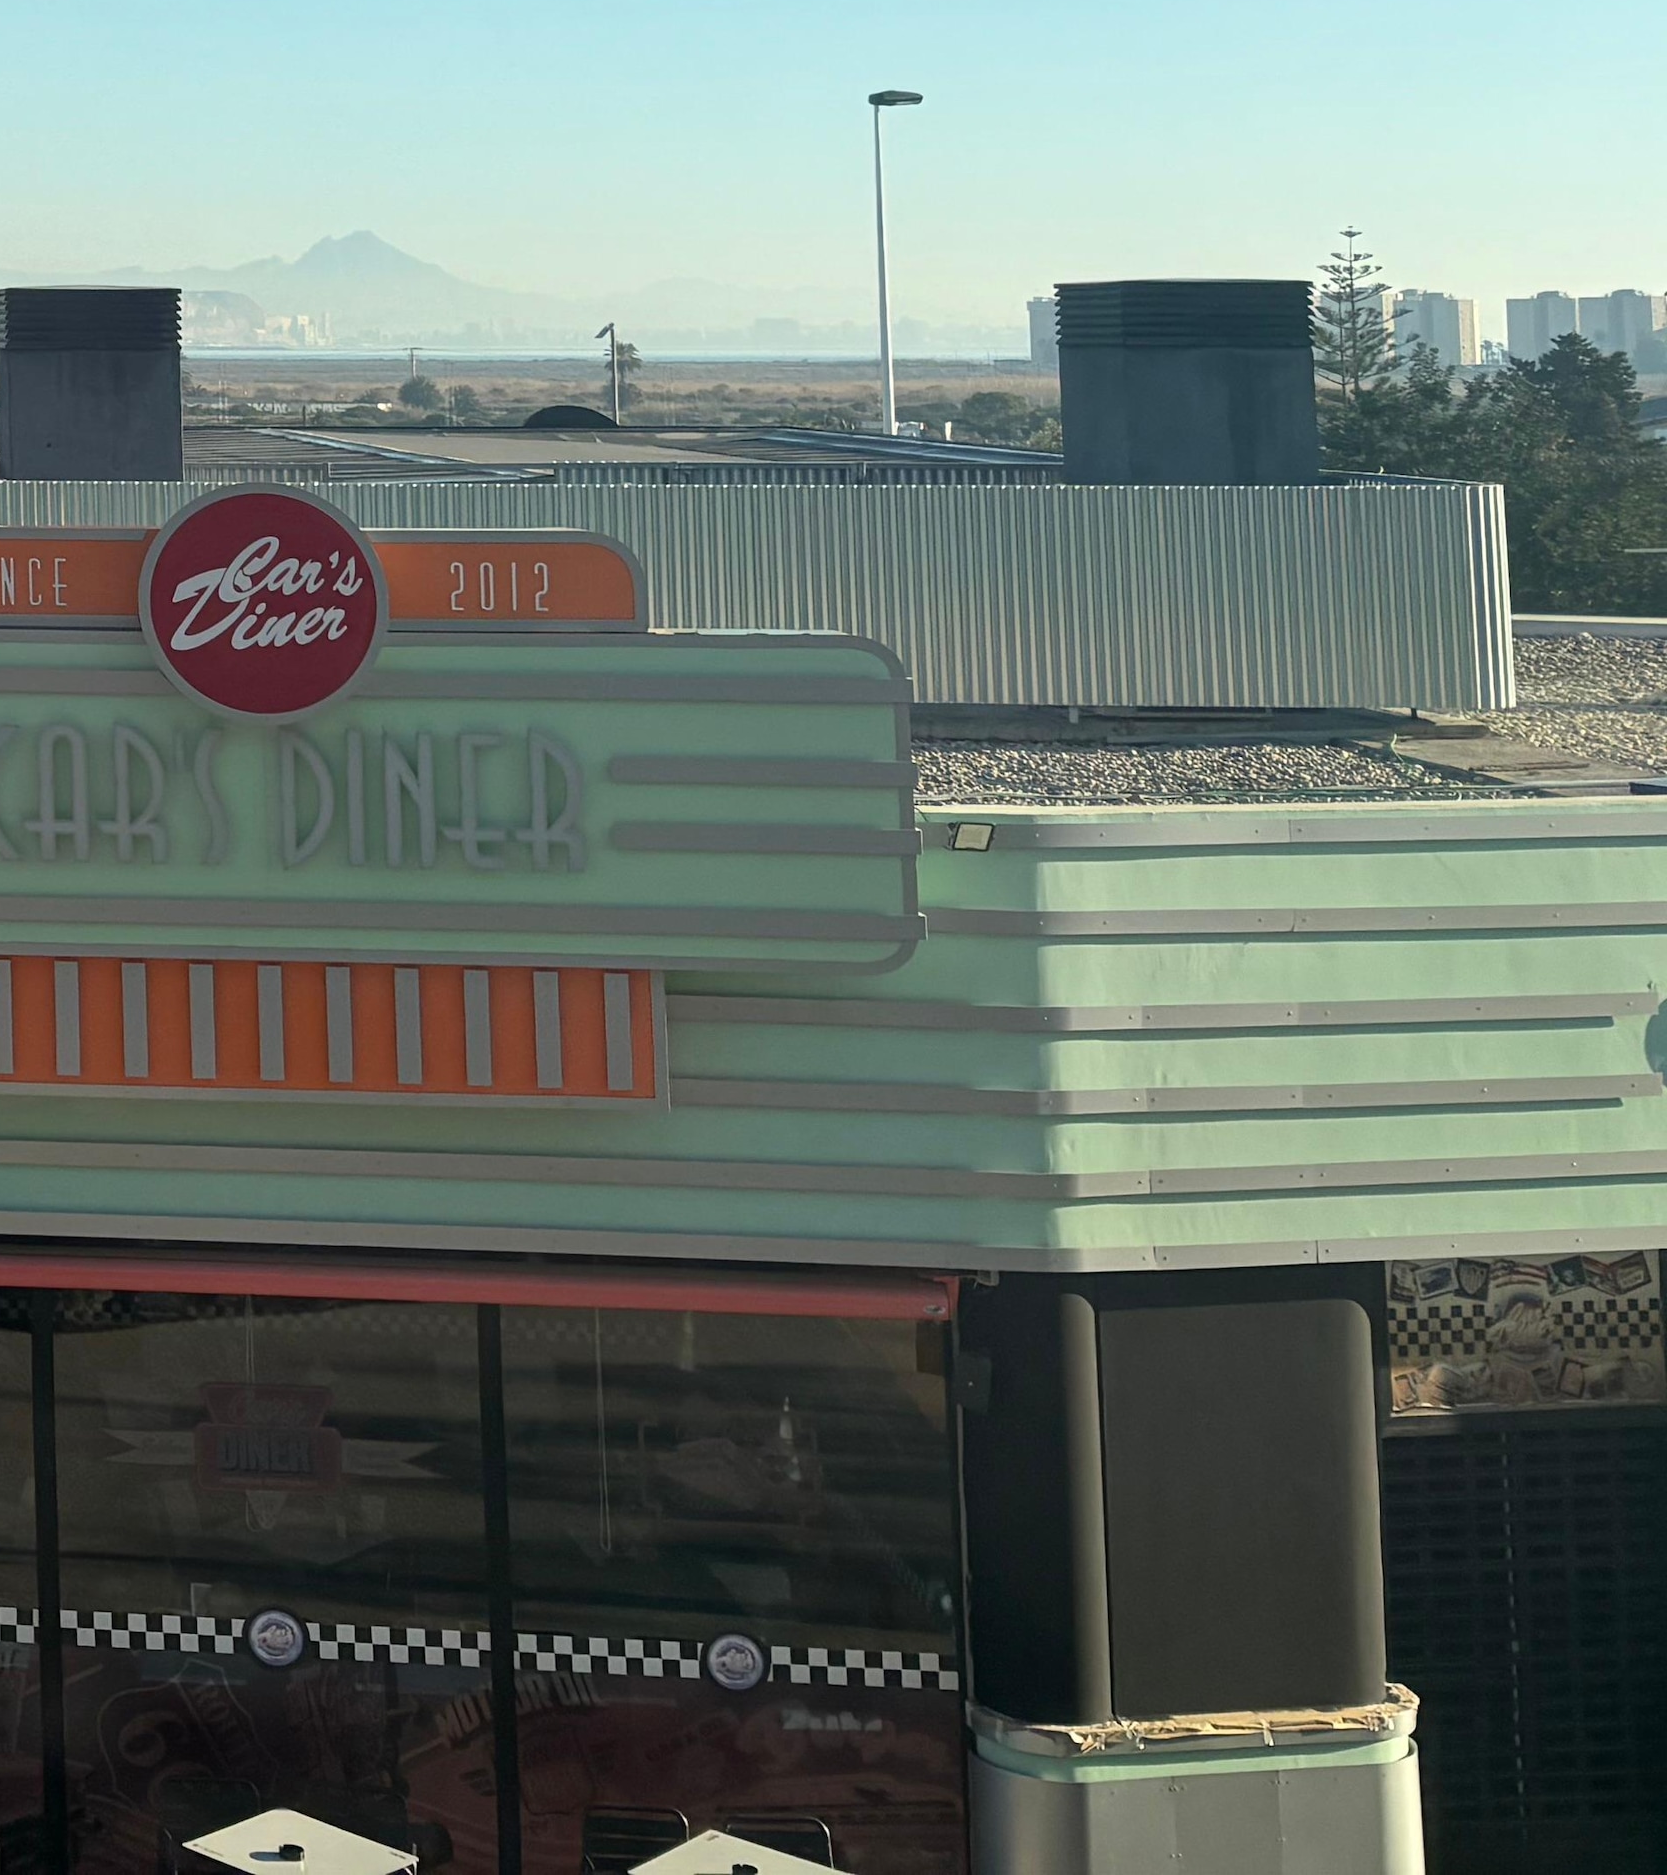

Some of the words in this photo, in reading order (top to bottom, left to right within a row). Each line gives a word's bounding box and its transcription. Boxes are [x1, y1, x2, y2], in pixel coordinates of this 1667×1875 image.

[218, 535, 363, 603] Car's
[450, 562, 549, 612] 2012
[170, 567, 348, 651] Diner
[281, 725, 586, 873] DINER
